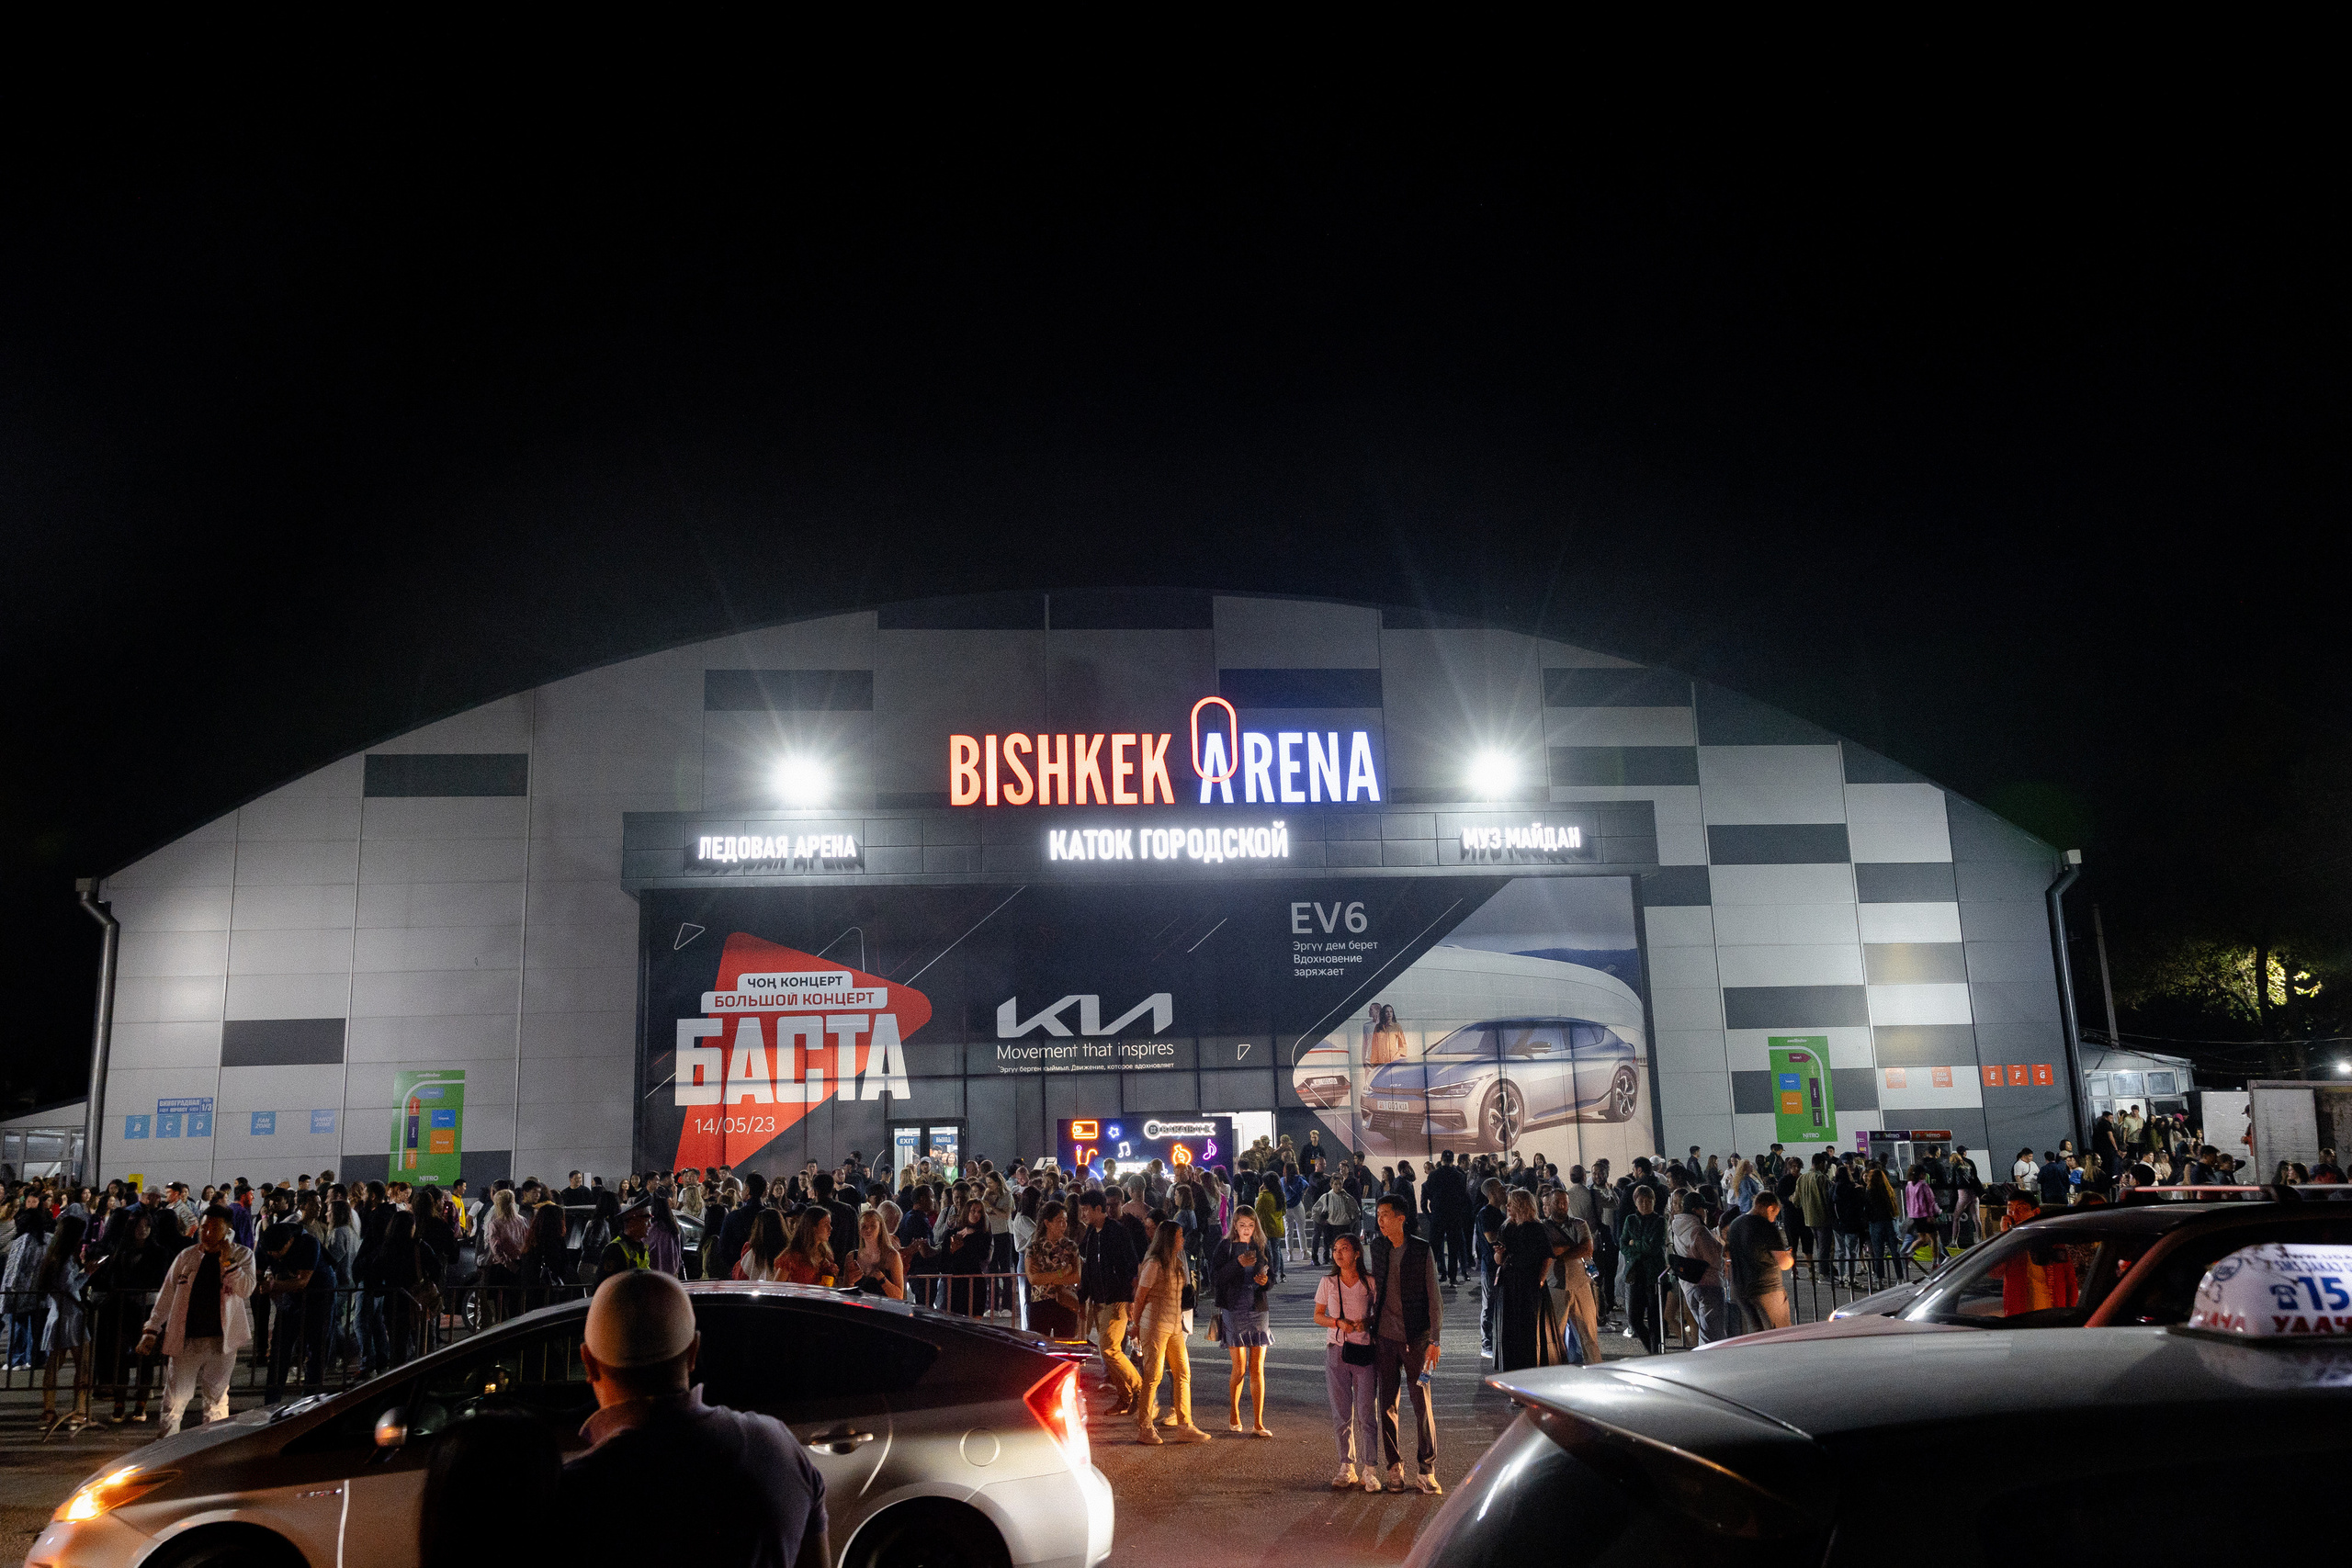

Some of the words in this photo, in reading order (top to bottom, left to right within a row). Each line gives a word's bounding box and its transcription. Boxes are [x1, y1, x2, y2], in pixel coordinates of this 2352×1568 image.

[949, 732, 1176, 807] BISHKEK
[1199, 730, 1382, 805] ARENA
[1049, 829, 1135, 861] КАТОК
[1139, 820, 1290, 863] ГОРОДСКОЙ
[1462, 826, 1502, 850] МУЗ
[1505, 822, 1581, 852] МАЙДАН
[698, 835, 789, 863] ЛЕДОВАЯ
[793, 835, 857, 859] АРЕНА
[1291, 901, 1368, 934] EV6
[1325, 942, 1346, 952] дем
[1348, 940, 1378, 952] берет
[1294, 953, 1363, 964] Вдохновение
[1294, 967, 1345, 978] заряжает
[780, 975, 843, 989] КОНЦЕРТ
[714, 991, 798, 1008] БОЛЬШОЙ
[802, 991, 875, 1007] КОНЦЕРТ
[997, 1043, 1079, 1060] Movement
[1082, 1042, 1113, 1057] that
[1117, 1041, 1174, 1059] inspires
[674, 1012, 911, 1107] БАСТА
[2040, 1071, 2046, 1079] G
[133, 1123, 141, 1132] B
[165, 1122, 174, 1131] C
[196, 1122, 204, 1130] D
[694, 1115, 775, 1135] 14/05/23
